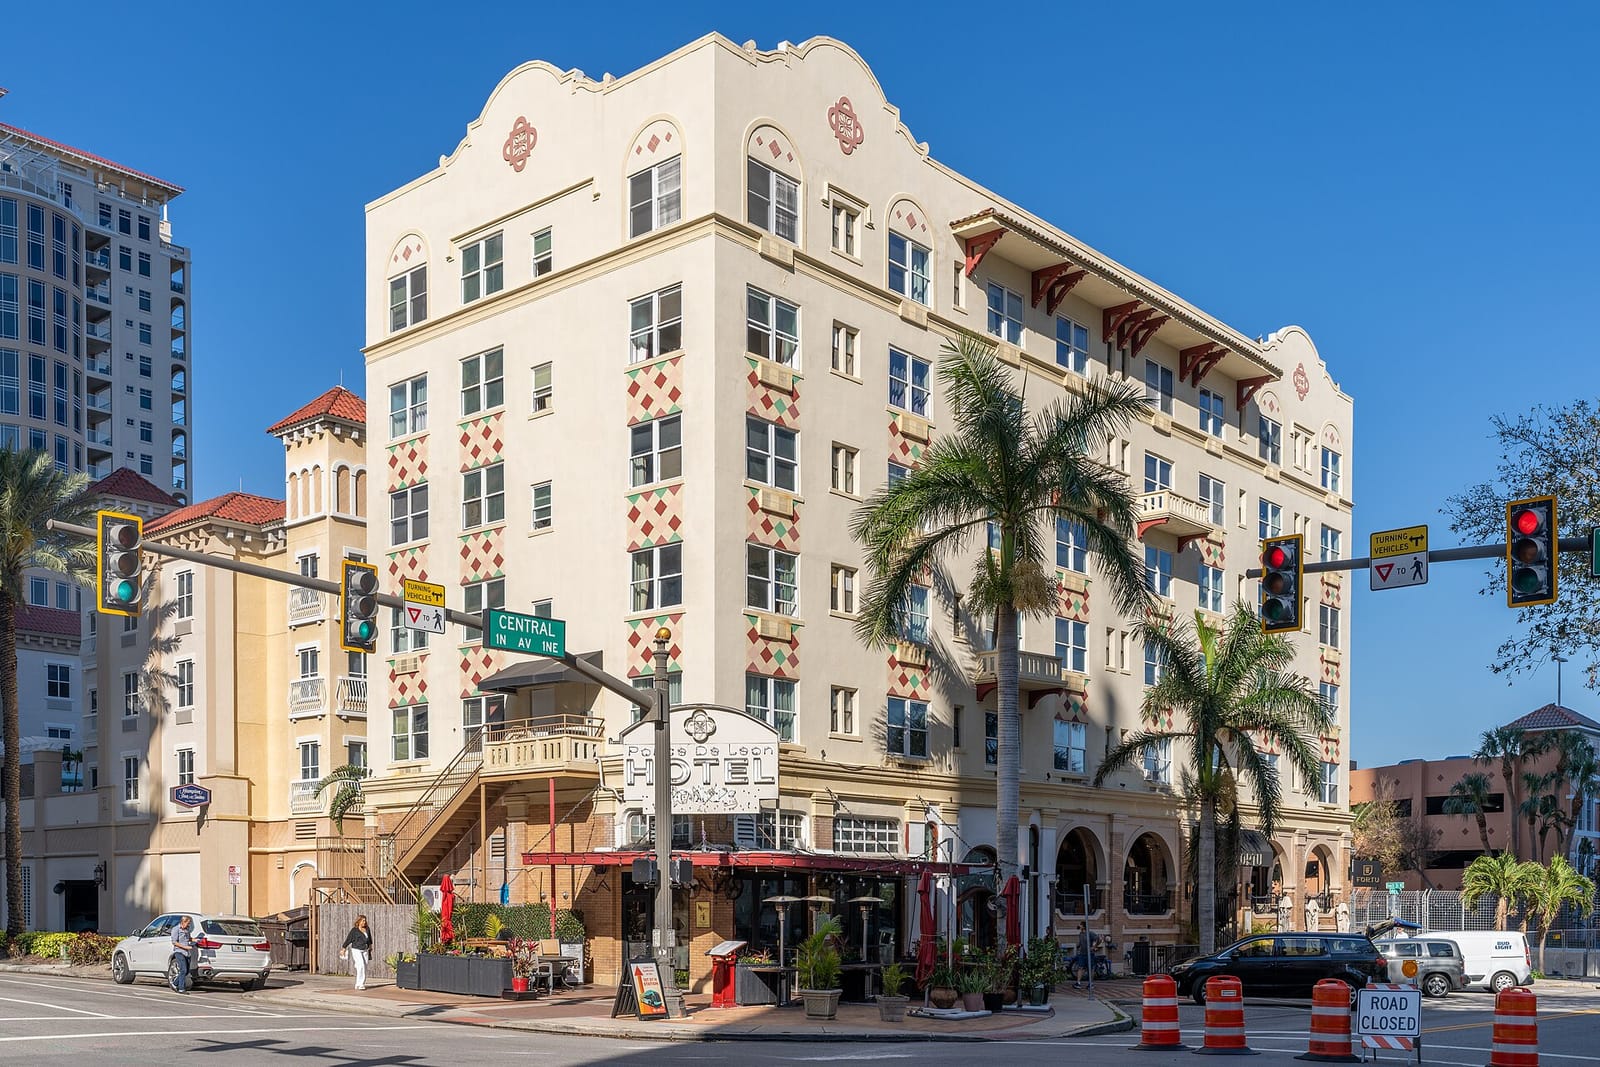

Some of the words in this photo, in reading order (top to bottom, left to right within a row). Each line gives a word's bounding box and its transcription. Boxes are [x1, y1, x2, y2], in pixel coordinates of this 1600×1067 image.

[1376, 533, 1408, 544] TURNING
[1374, 543, 1409, 554] VEHICLES
[1396, 567, 1406, 575] TO
[407, 583, 431, 593] TURNING
[406, 592, 432, 602] VEHICLES
[499, 615, 556, 637] CENTRAL
[518, 639, 531, 649] AV
[628, 746, 687, 756] Poe
[626, 757, 775, 786] HOTEL
[1240, 853, 1263, 866] ORTU
[1370, 996, 1408, 1011] ROAD
[1361, 1015, 1416, 1031] CLOSED
